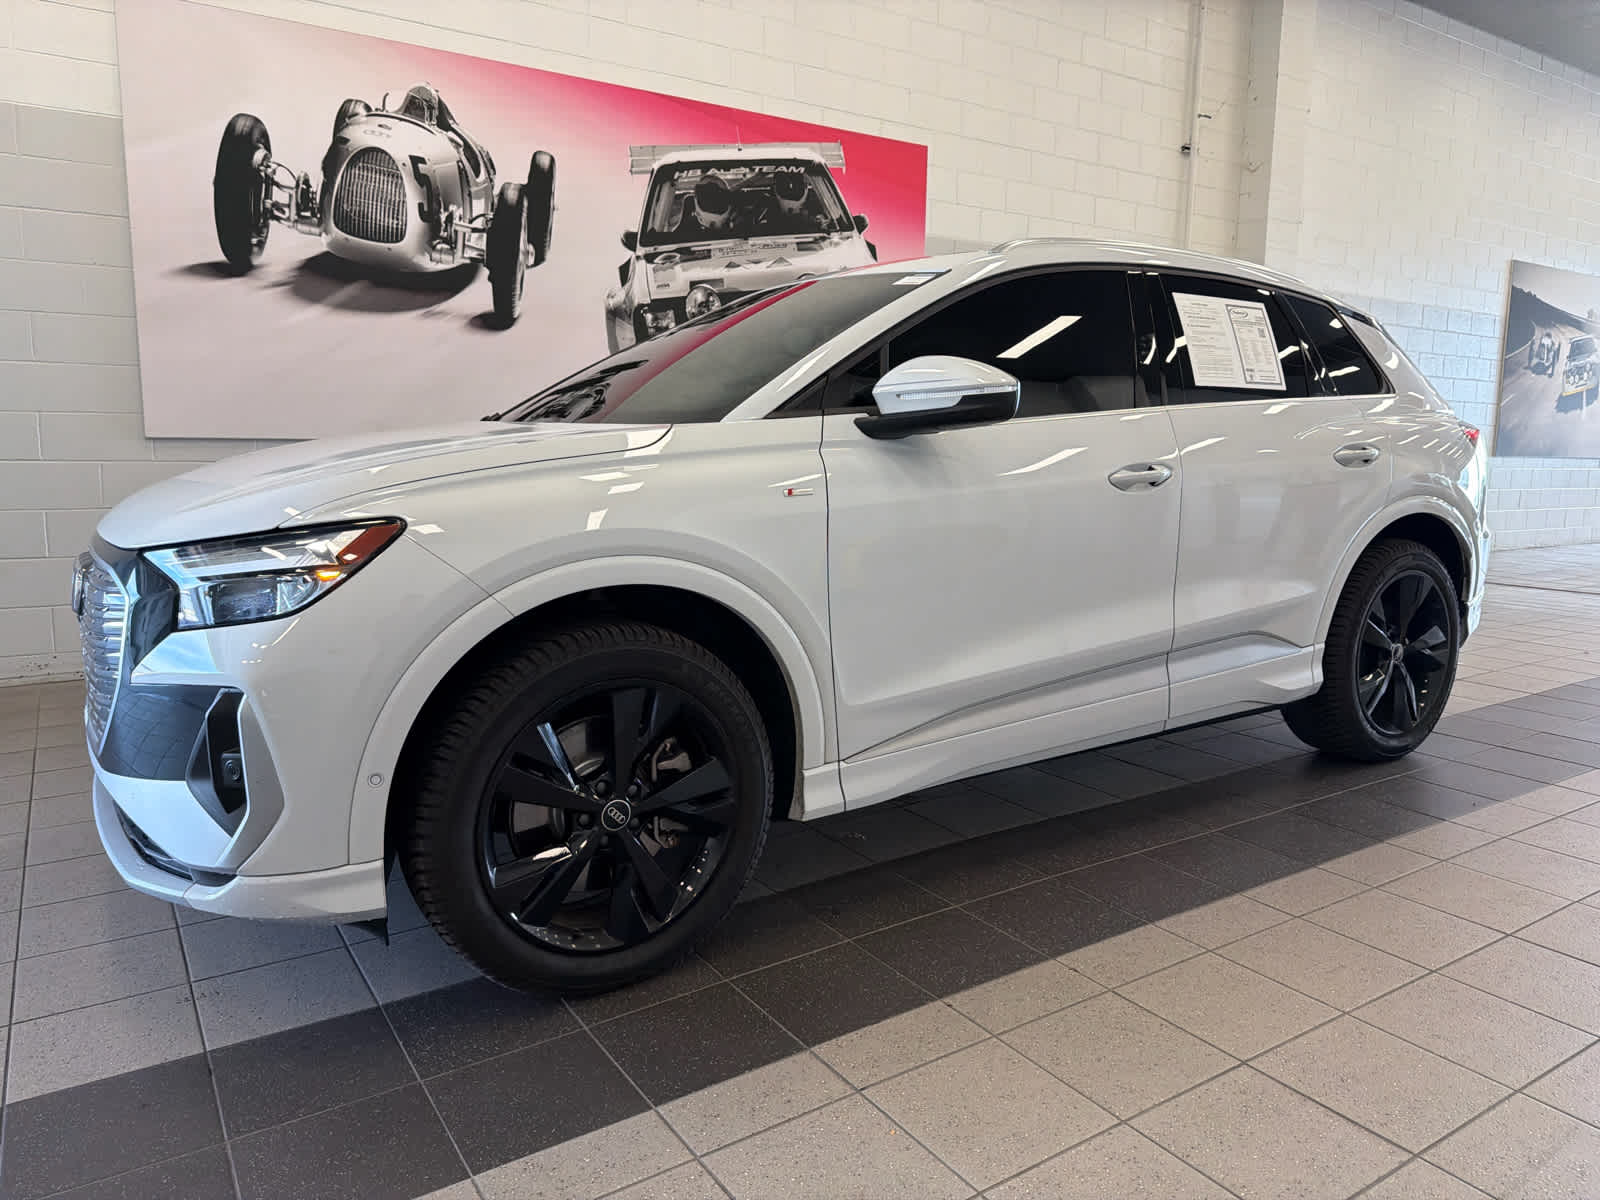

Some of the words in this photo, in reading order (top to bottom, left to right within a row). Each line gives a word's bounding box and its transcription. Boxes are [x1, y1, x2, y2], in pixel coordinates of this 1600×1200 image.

[408, 155, 434, 223] 5
[673, 169, 702, 179] HB
[752, 165, 806, 174] TEAM
